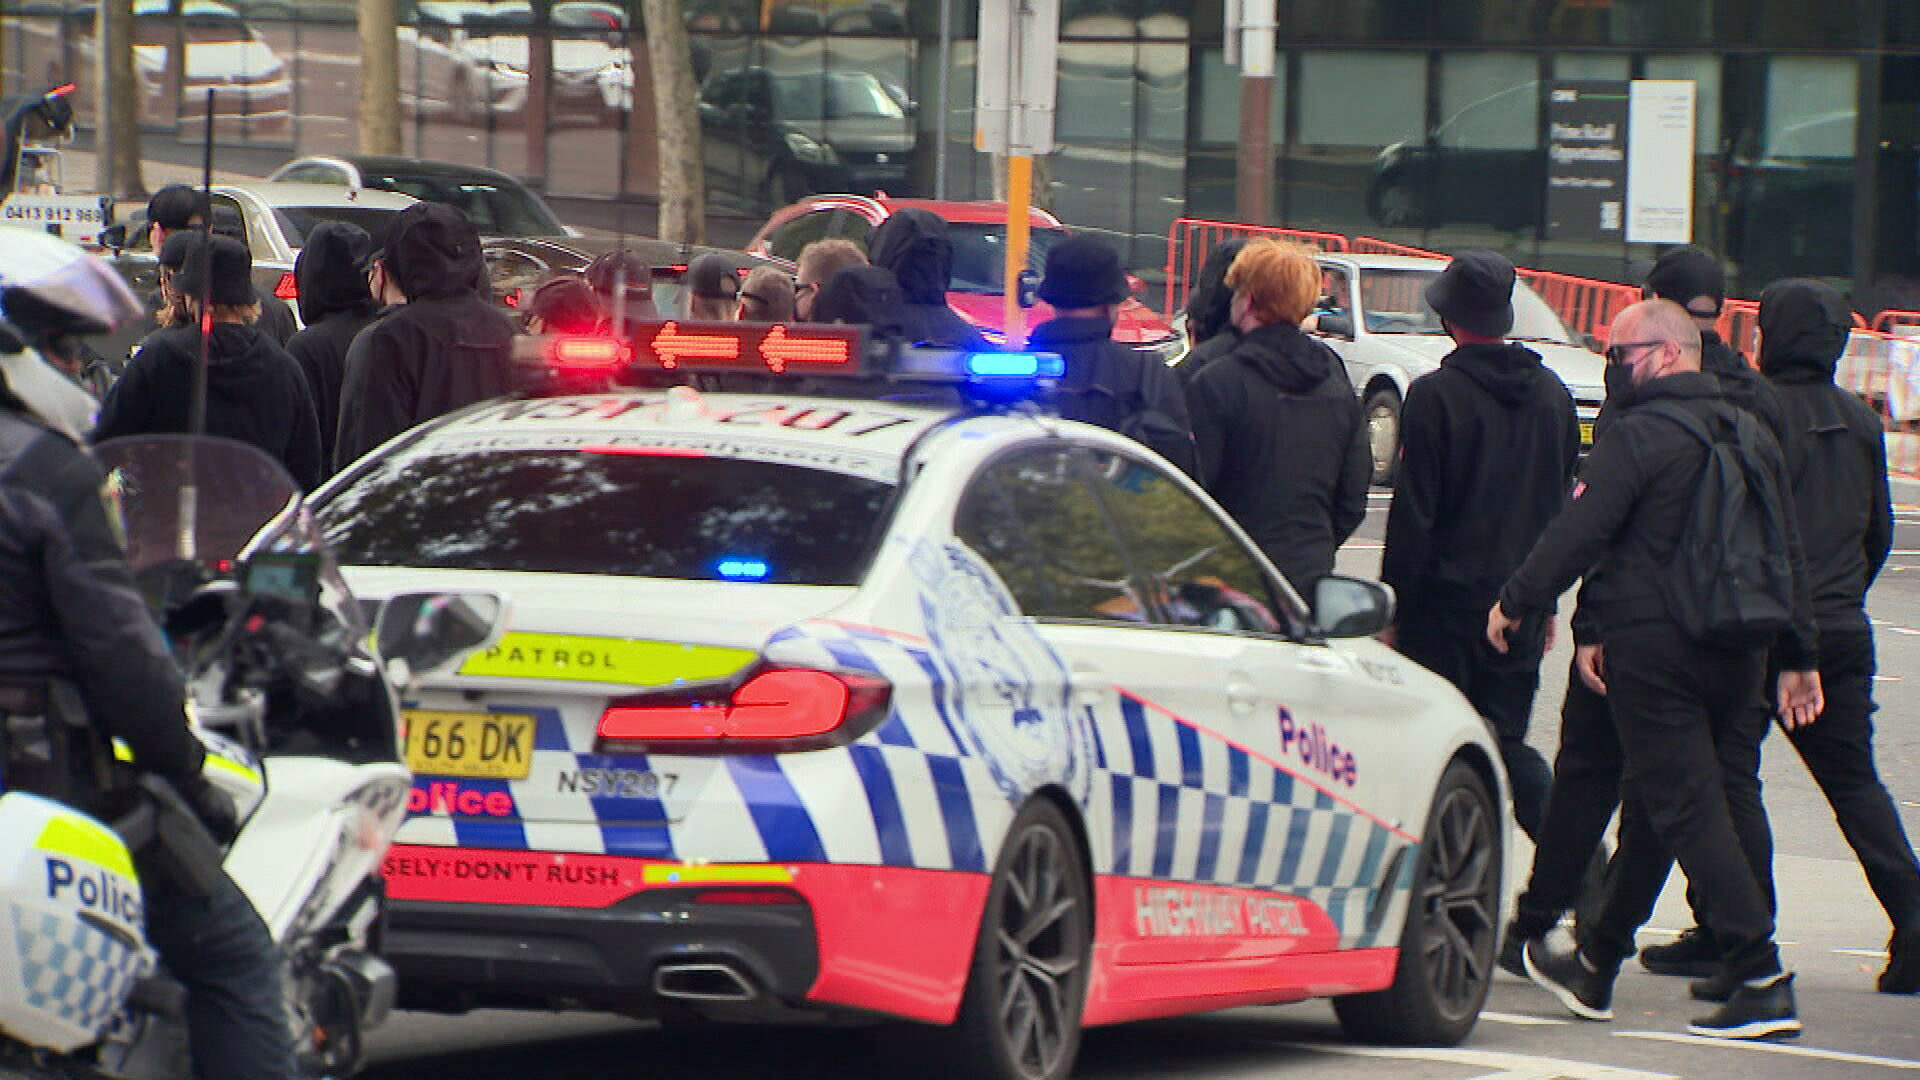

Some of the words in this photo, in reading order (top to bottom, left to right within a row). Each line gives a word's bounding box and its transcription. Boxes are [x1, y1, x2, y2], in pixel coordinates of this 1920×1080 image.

[486, 647, 614, 669] PATROL
[1277, 704, 1357, 788] Police
[407, 782, 513, 817] olice
[557, 770, 680, 799] NSY207
[546, 865, 618, 886] RUSH
[1135, 886, 1245, 937] HIGHWAY
[1246, 896, 1310, 936] PATROL
